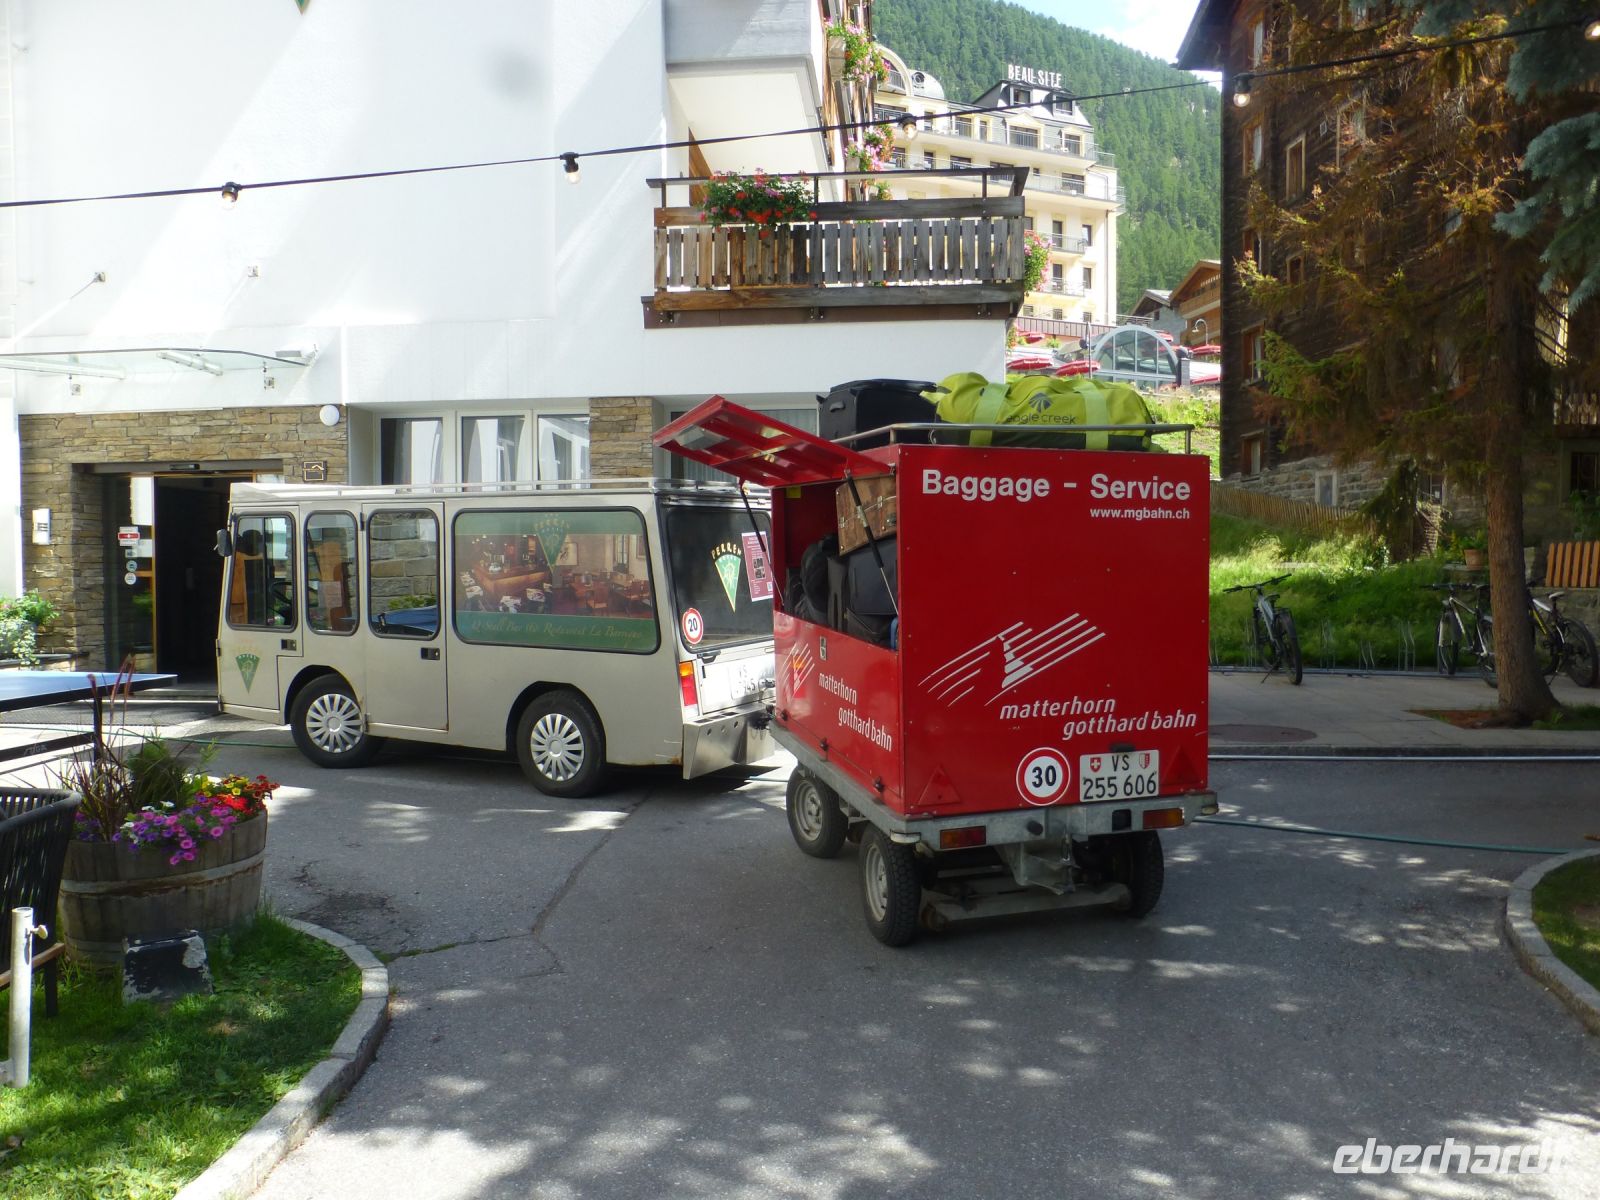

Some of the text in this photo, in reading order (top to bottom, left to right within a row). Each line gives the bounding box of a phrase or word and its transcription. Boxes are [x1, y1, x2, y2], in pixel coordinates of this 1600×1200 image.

[1041, 414, 1077, 424] creek
[922, 469, 1050, 502] Baggage
[1090, 473, 1191, 500] Service
[1090, 507, 1190, 520] www.mgbahn.ch
[711, 542, 742, 559] PERREN
[688, 618, 698, 632] 20
[818, 672, 857, 705] matterhorn
[1000, 696, 1116, 719] matterhorn
[838, 707, 892, 752] gotthard bahn
[1062, 709, 1197, 740] gotthard bahn
[1112, 754, 1130, 772] VS
[1031, 765, 1057, 788] 30
[1083, 774, 1157, 800] 255 606
